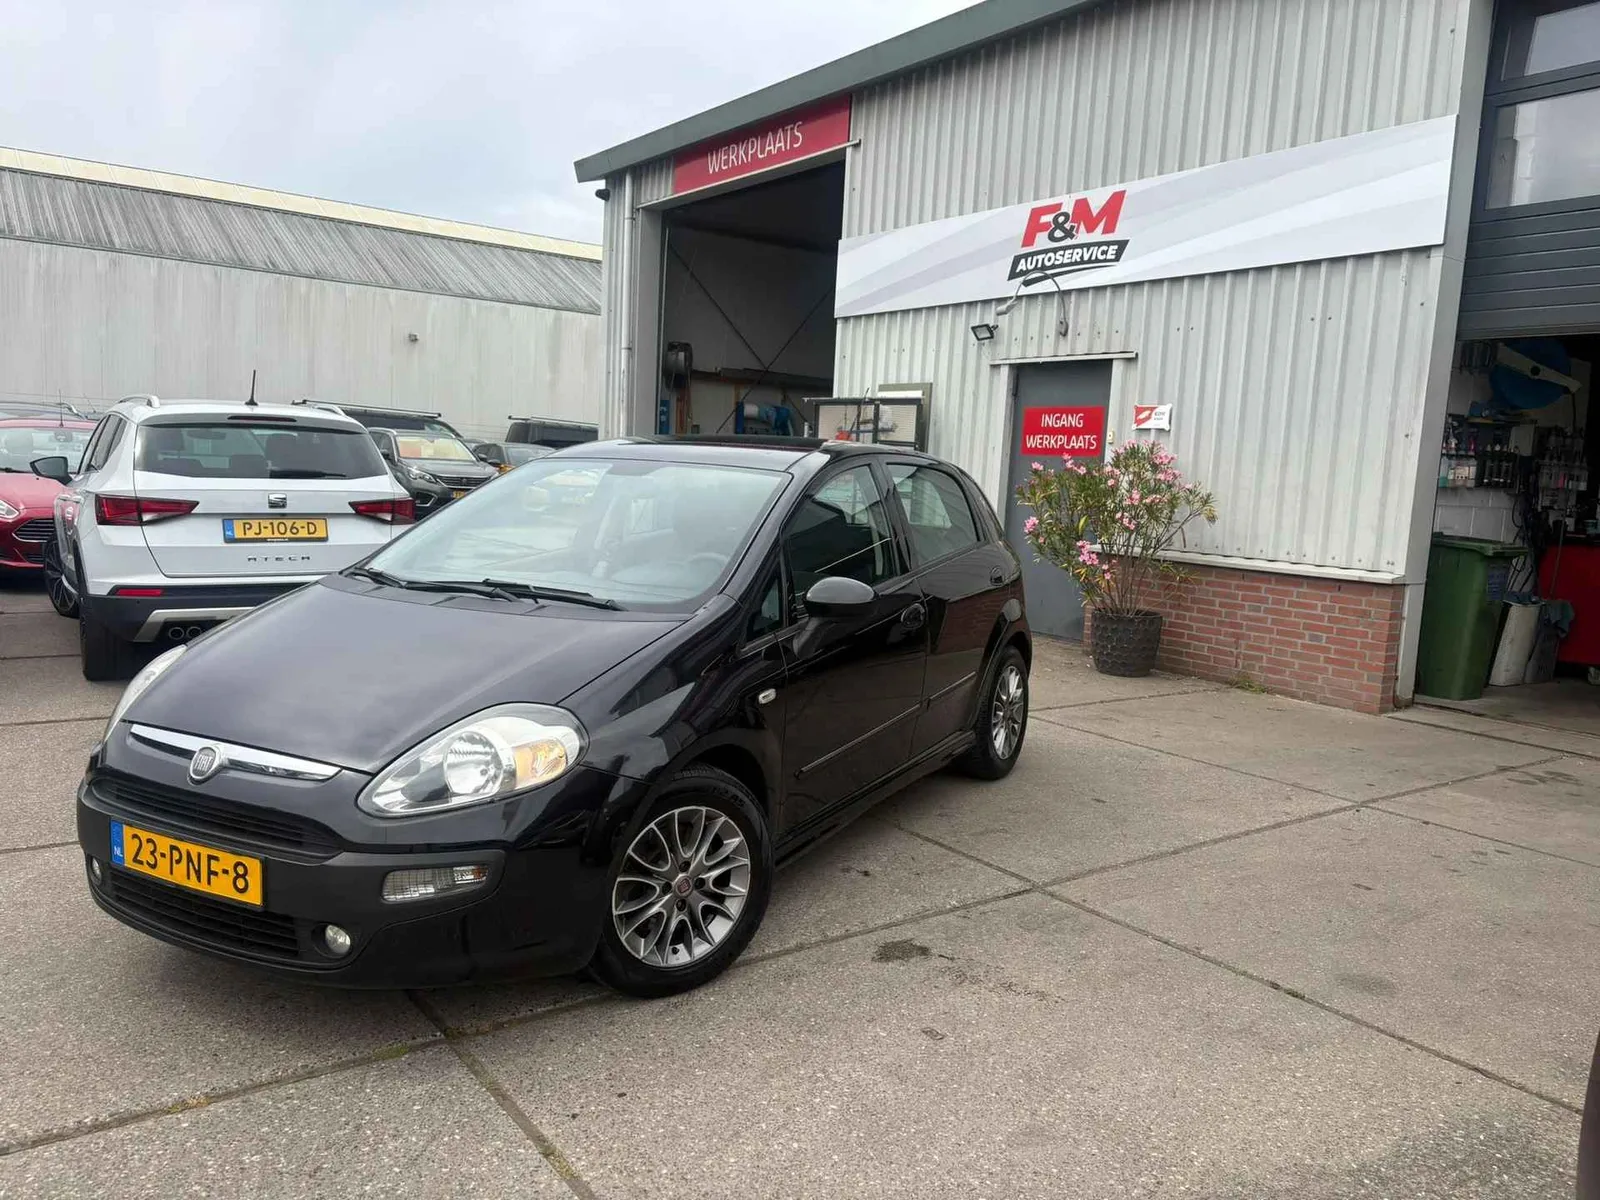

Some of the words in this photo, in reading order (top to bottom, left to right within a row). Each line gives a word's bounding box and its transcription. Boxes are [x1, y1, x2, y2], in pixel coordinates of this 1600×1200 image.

[707, 121, 803, 174] WERKPLAATS
[1020, 189, 1127, 248] F&M
[1015, 244, 1118, 273] AUTOSERVICE
[1041, 413, 1084, 428] INGANG
[1026, 434, 1097, 450] WERKPLAATS
[242, 521, 317, 536] PJ-106-D
[247, 554, 311, 562] ATECA
[113, 846, 124, 857] NL
[131, 833, 249, 894] 23-PNF-8
